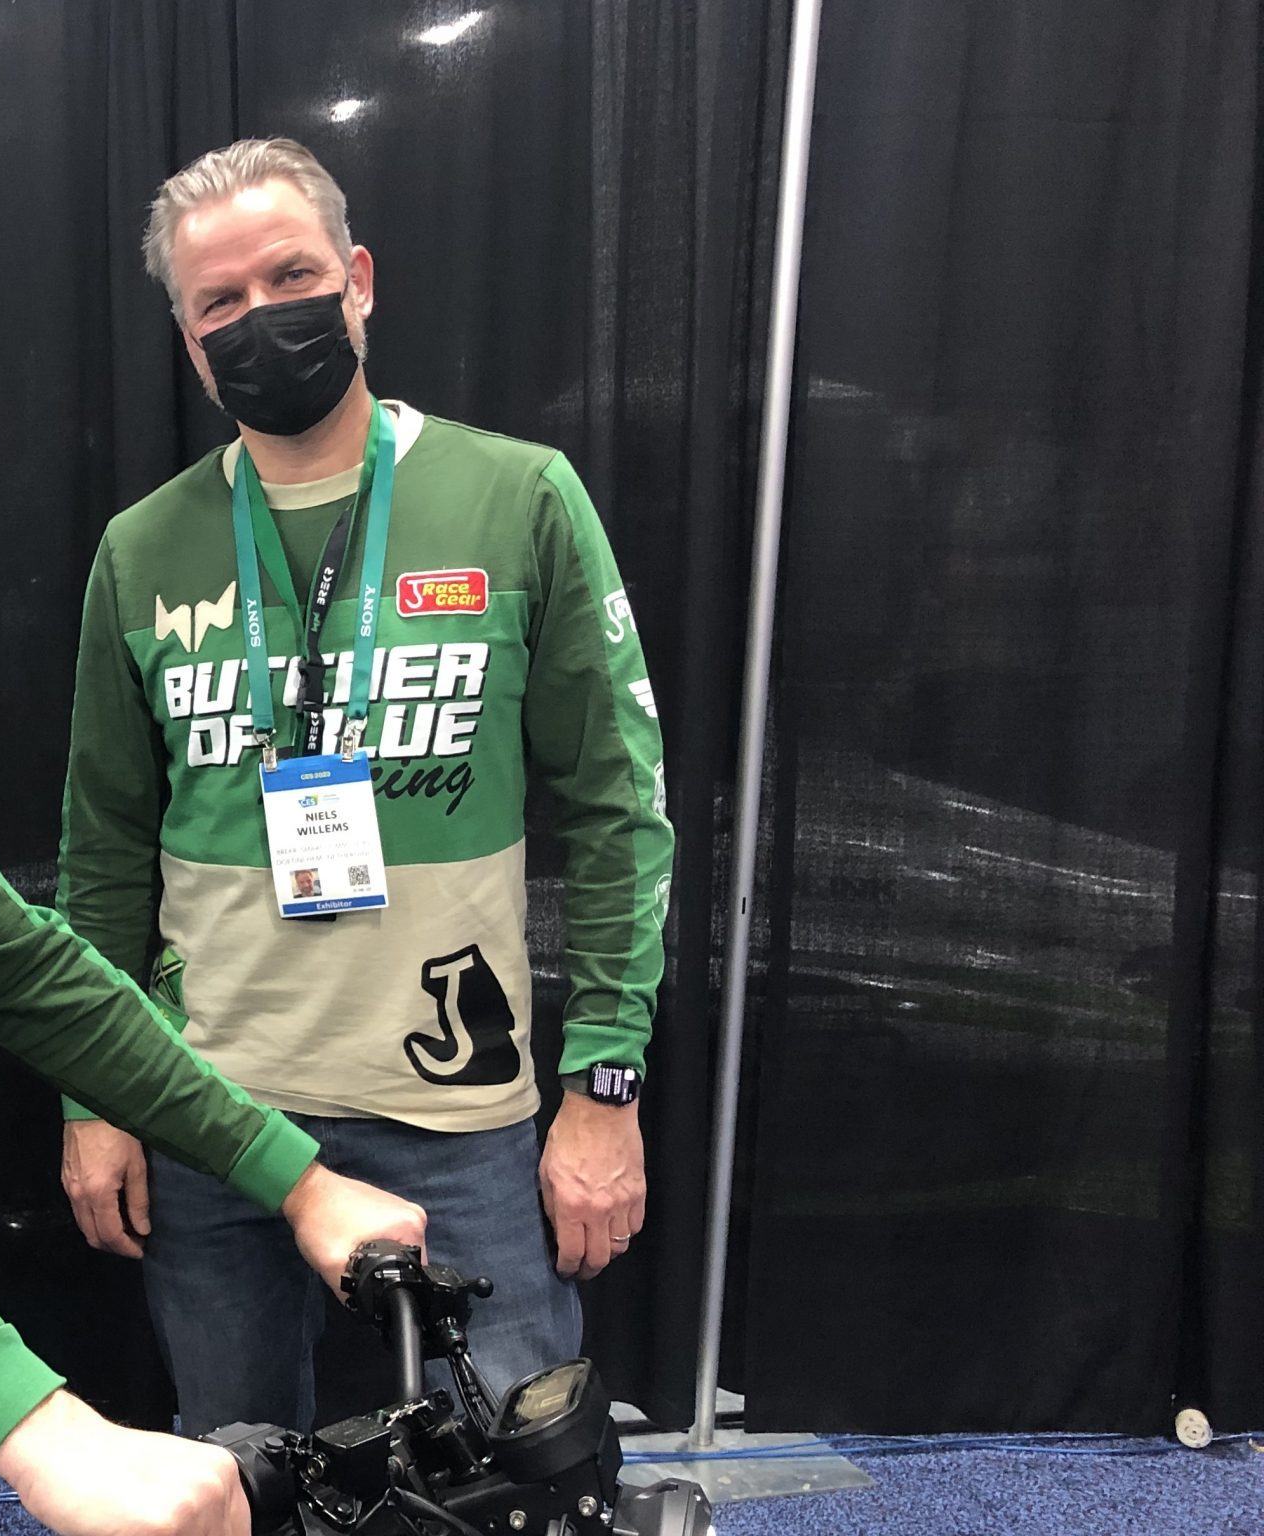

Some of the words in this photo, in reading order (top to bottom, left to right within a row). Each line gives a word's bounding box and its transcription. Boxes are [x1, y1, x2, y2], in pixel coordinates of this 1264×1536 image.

[422, 583, 470, 596] Race
[436, 592, 481, 607] Gear
[360, 584, 376, 637] SONY
[247, 598, 261, 648] SONY
[371, 757, 476, 816] ing
[305, 810, 338, 823] NIELS
[297, 822, 349, 836] WILLEMS
[316, 900, 353, 911] Exhibitor
